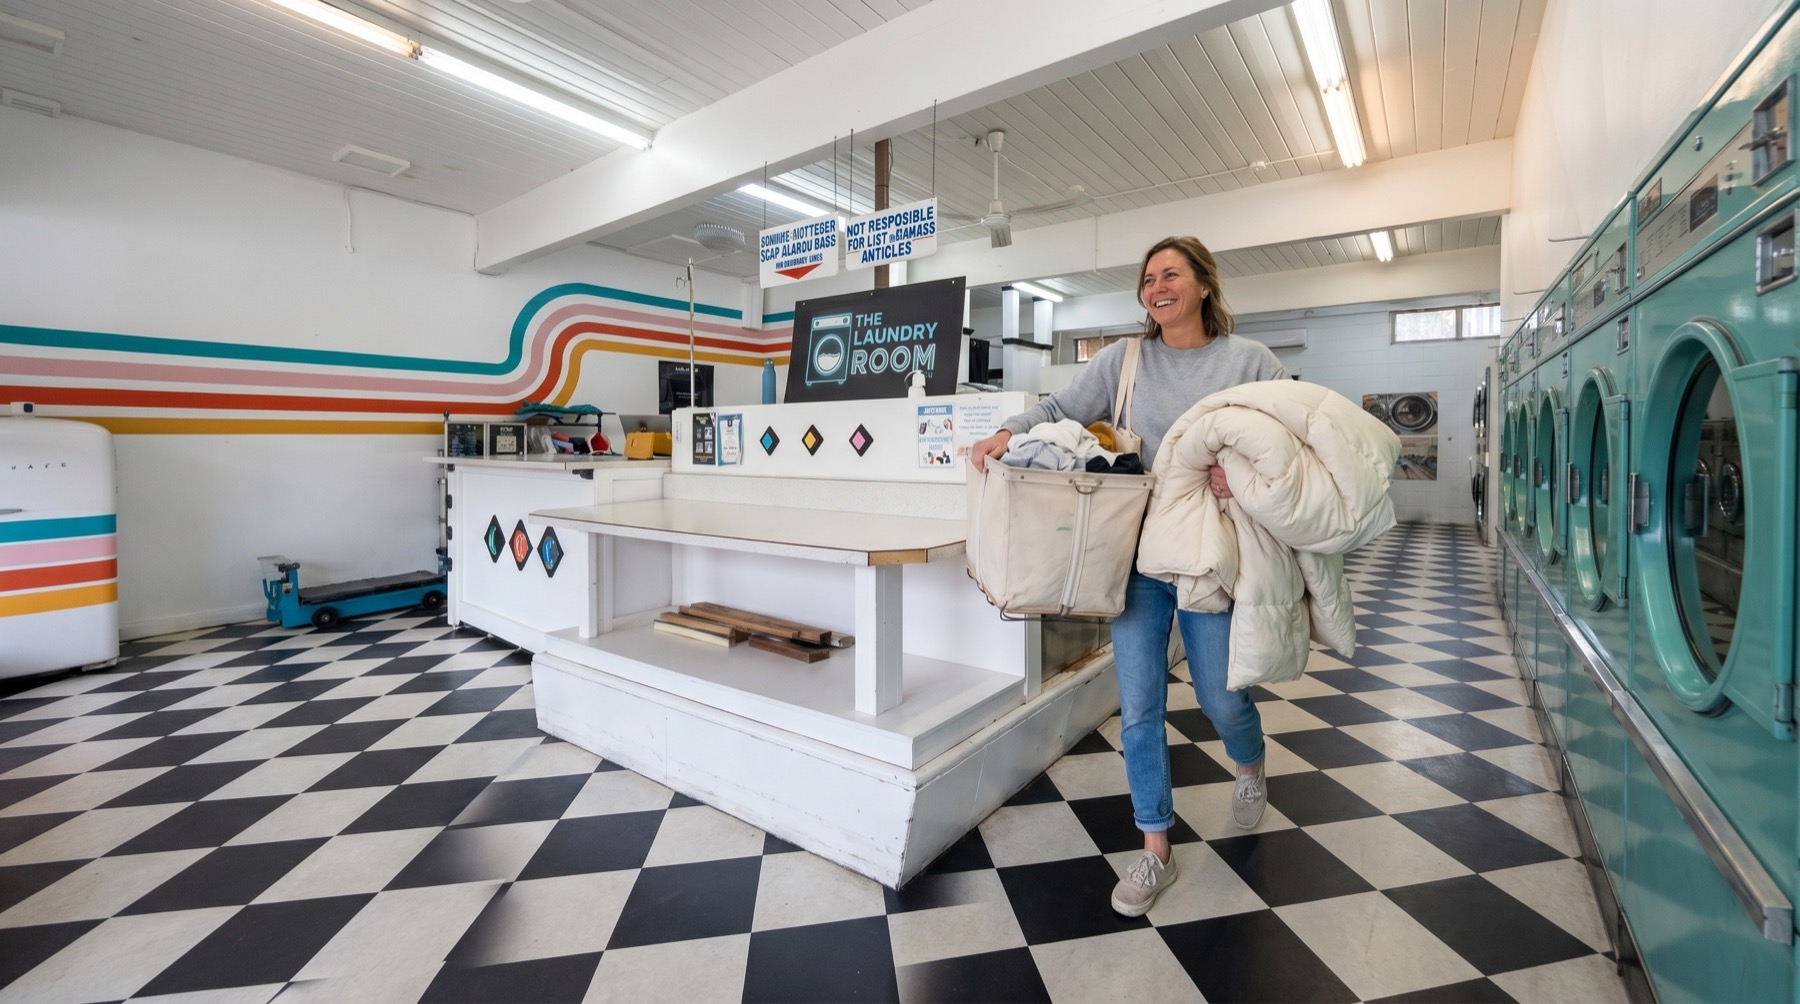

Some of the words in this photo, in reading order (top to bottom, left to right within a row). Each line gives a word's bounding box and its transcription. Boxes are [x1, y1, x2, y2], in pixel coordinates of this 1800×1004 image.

[847, 221, 865, 237] NOT
[869, 206, 934, 233] RESPOSIBLE
[761, 247, 780, 262] SCAP
[814, 234, 836, 250] BASS
[848, 237, 865, 251] FOR
[868, 232, 888, 247] LIST
[861, 241, 912, 264] ANTICLES
[809, 253, 823, 263] LINES
[855, 312, 883, 327] THE
[853, 322, 938, 346] LAUNDRY
[850, 343, 937, 375] ROOM
